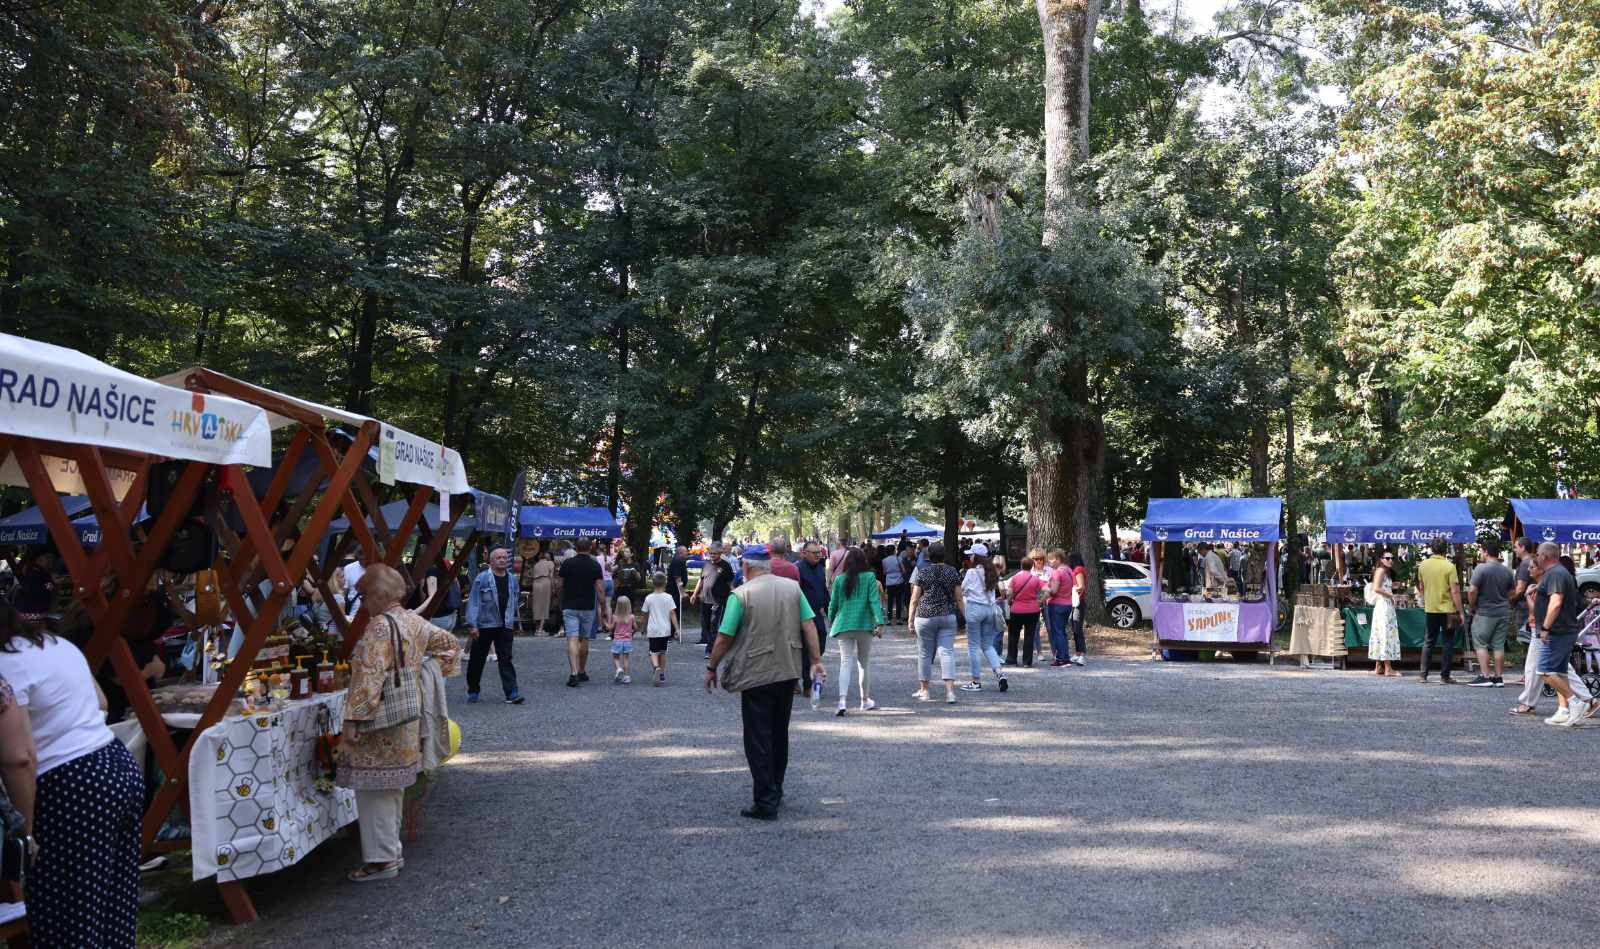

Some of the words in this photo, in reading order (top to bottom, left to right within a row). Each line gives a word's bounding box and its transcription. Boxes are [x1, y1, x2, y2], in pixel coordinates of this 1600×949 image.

[67, 383, 156, 426] NAŠICE
[395, 440, 413, 463] GRAD
[554, 527, 575, 536] Grad
[1184, 528, 1214, 538] Grad
[1374, 529, 1406, 540] Grad
